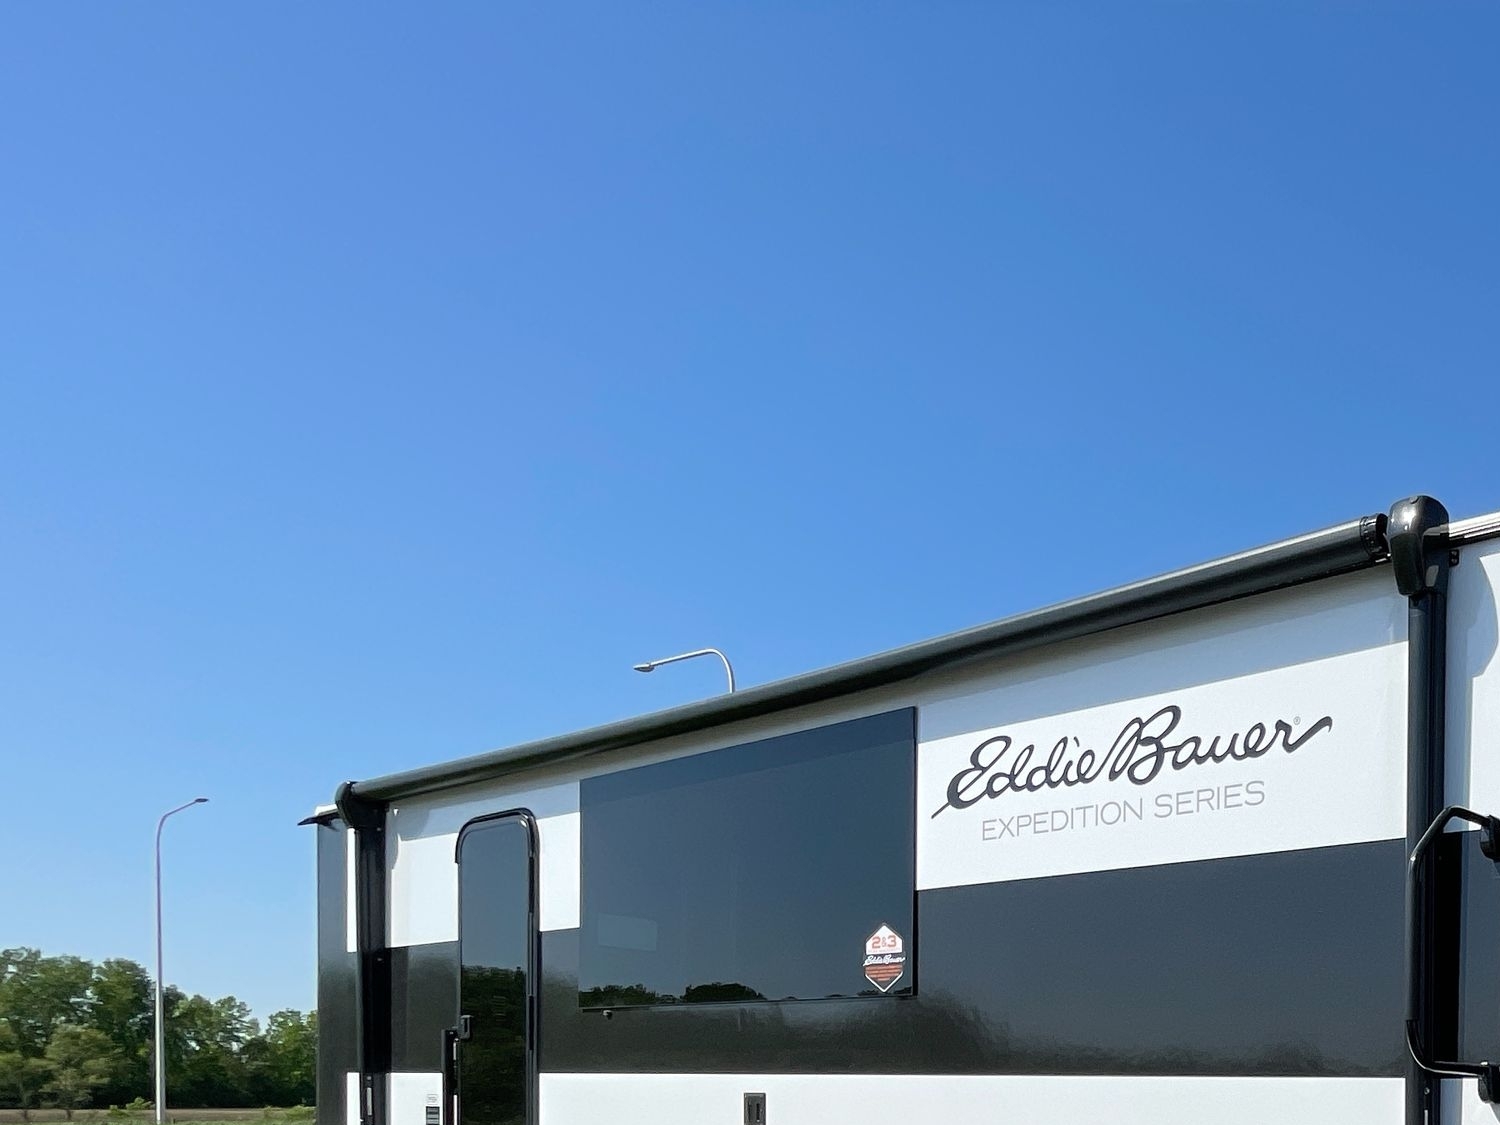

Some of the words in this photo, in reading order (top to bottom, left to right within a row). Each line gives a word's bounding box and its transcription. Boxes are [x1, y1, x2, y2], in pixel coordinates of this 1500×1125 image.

[931, 734, 1102, 820] Eddie
[1108, 704, 1333, 786] Bauer
[981, 798, 1144, 841] EXPEDITION
[1153, 780, 1267, 819] SERIES
